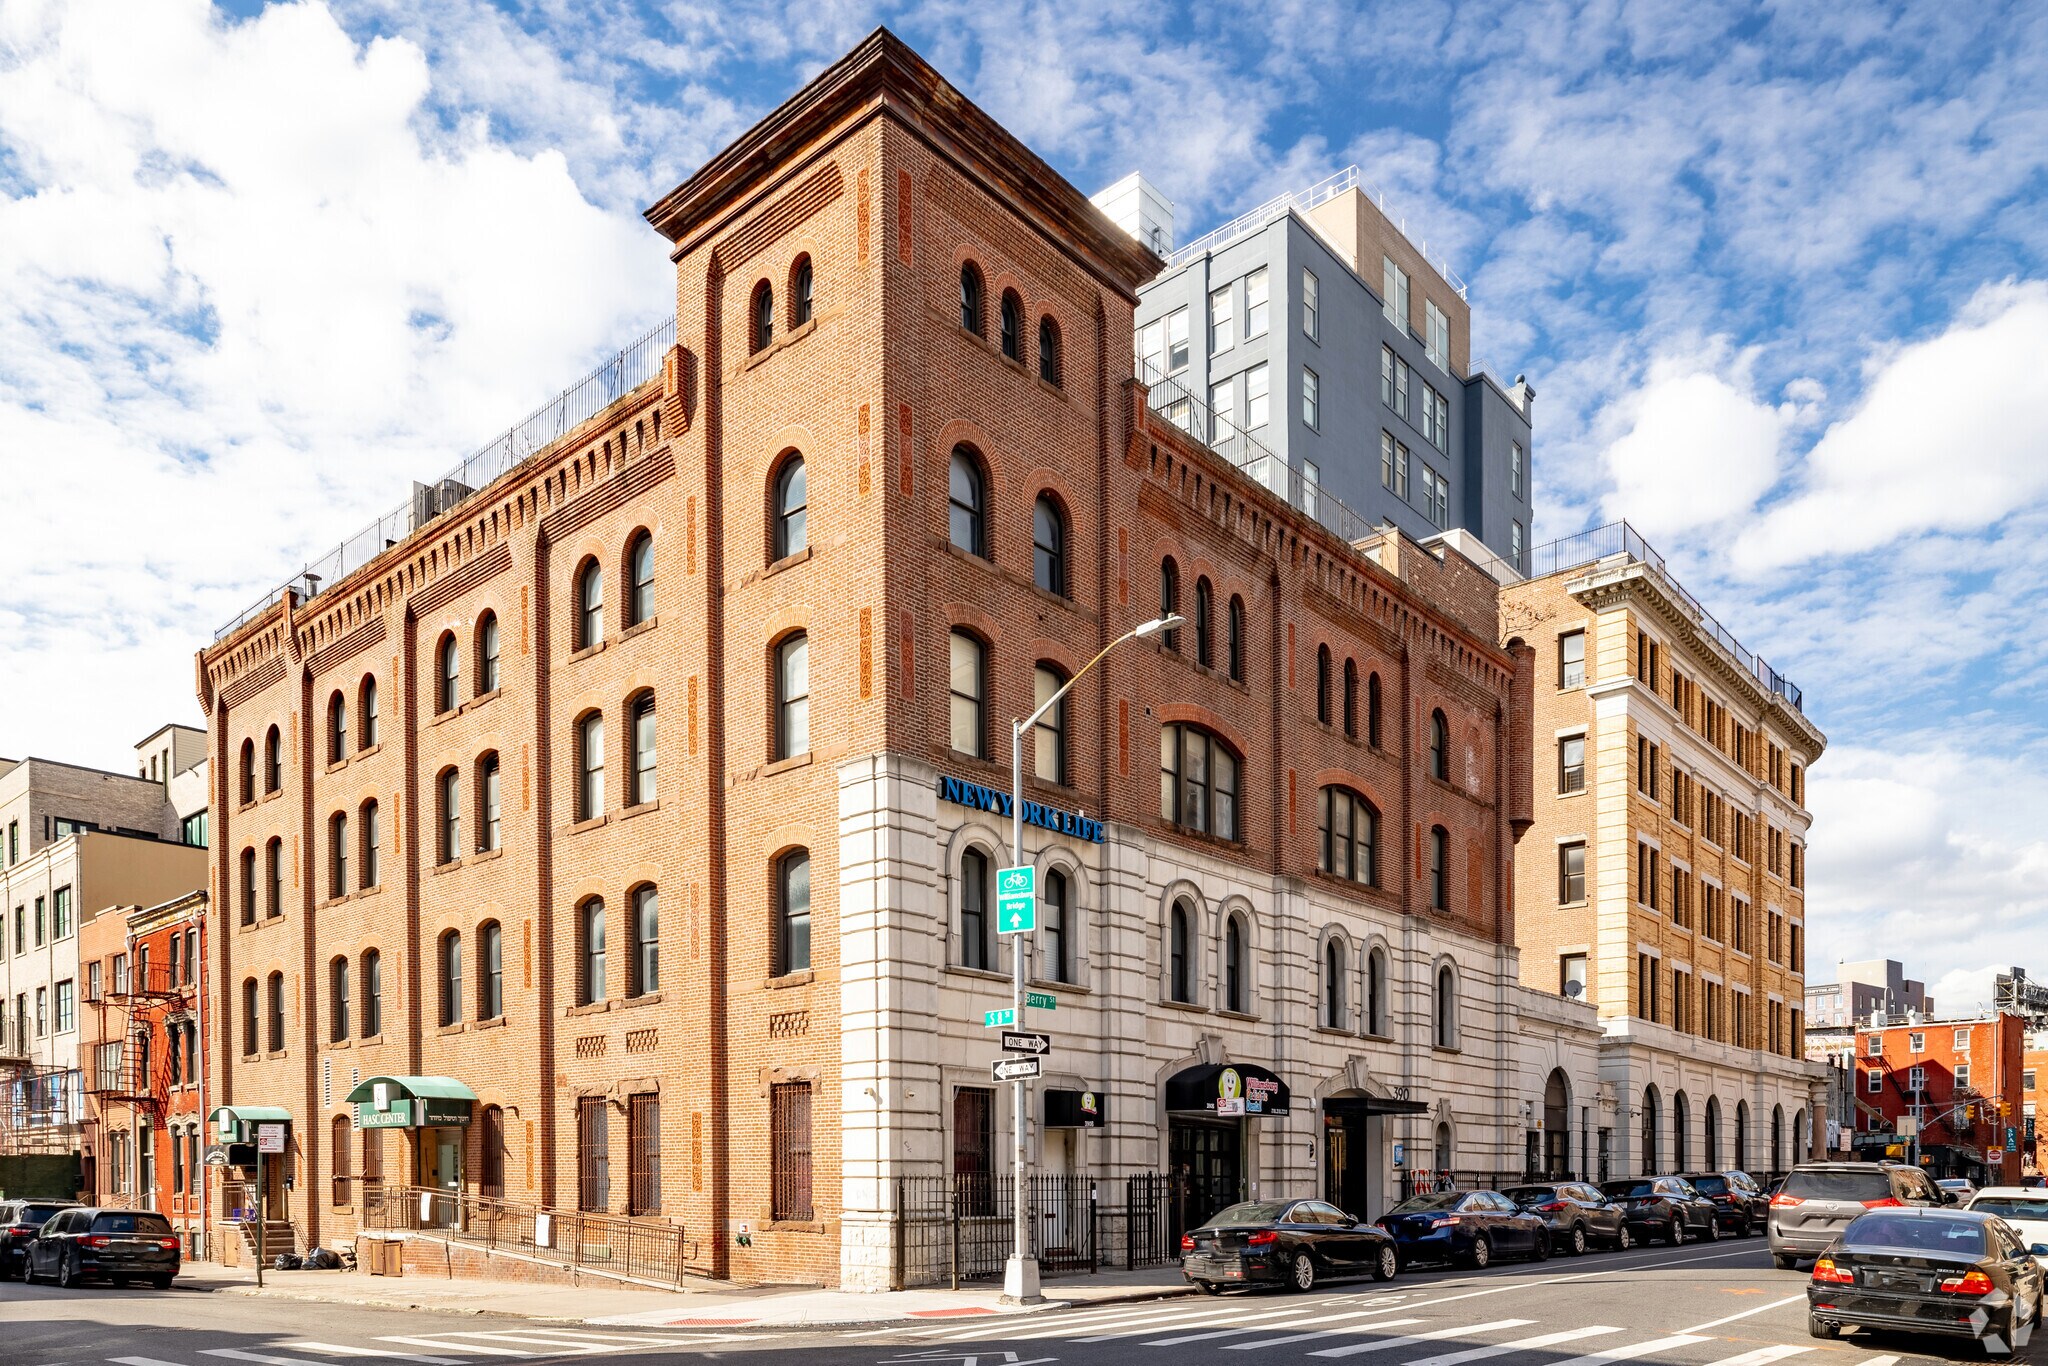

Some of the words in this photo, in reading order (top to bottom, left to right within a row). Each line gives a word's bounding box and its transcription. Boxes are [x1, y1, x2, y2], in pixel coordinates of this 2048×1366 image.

[945, 776, 996, 811] NEW
[1062, 811, 1104, 844] LIFE
[1006, 902, 1026, 910] Bridge
[1026, 993, 1047, 1008] Berry
[990, 1012, 995, 1025] S
[1008, 1037, 1023, 1047] ONE
[1028, 1039, 1043, 1048] WAY
[1000, 1065, 1013, 1075] ONE
[1019, 1063, 1034, 1072] WAY
[1393, 1087, 1409, 1100] 390
[363, 1114, 380, 1125] HASC
[381, 1112, 406, 1124] CENTER
